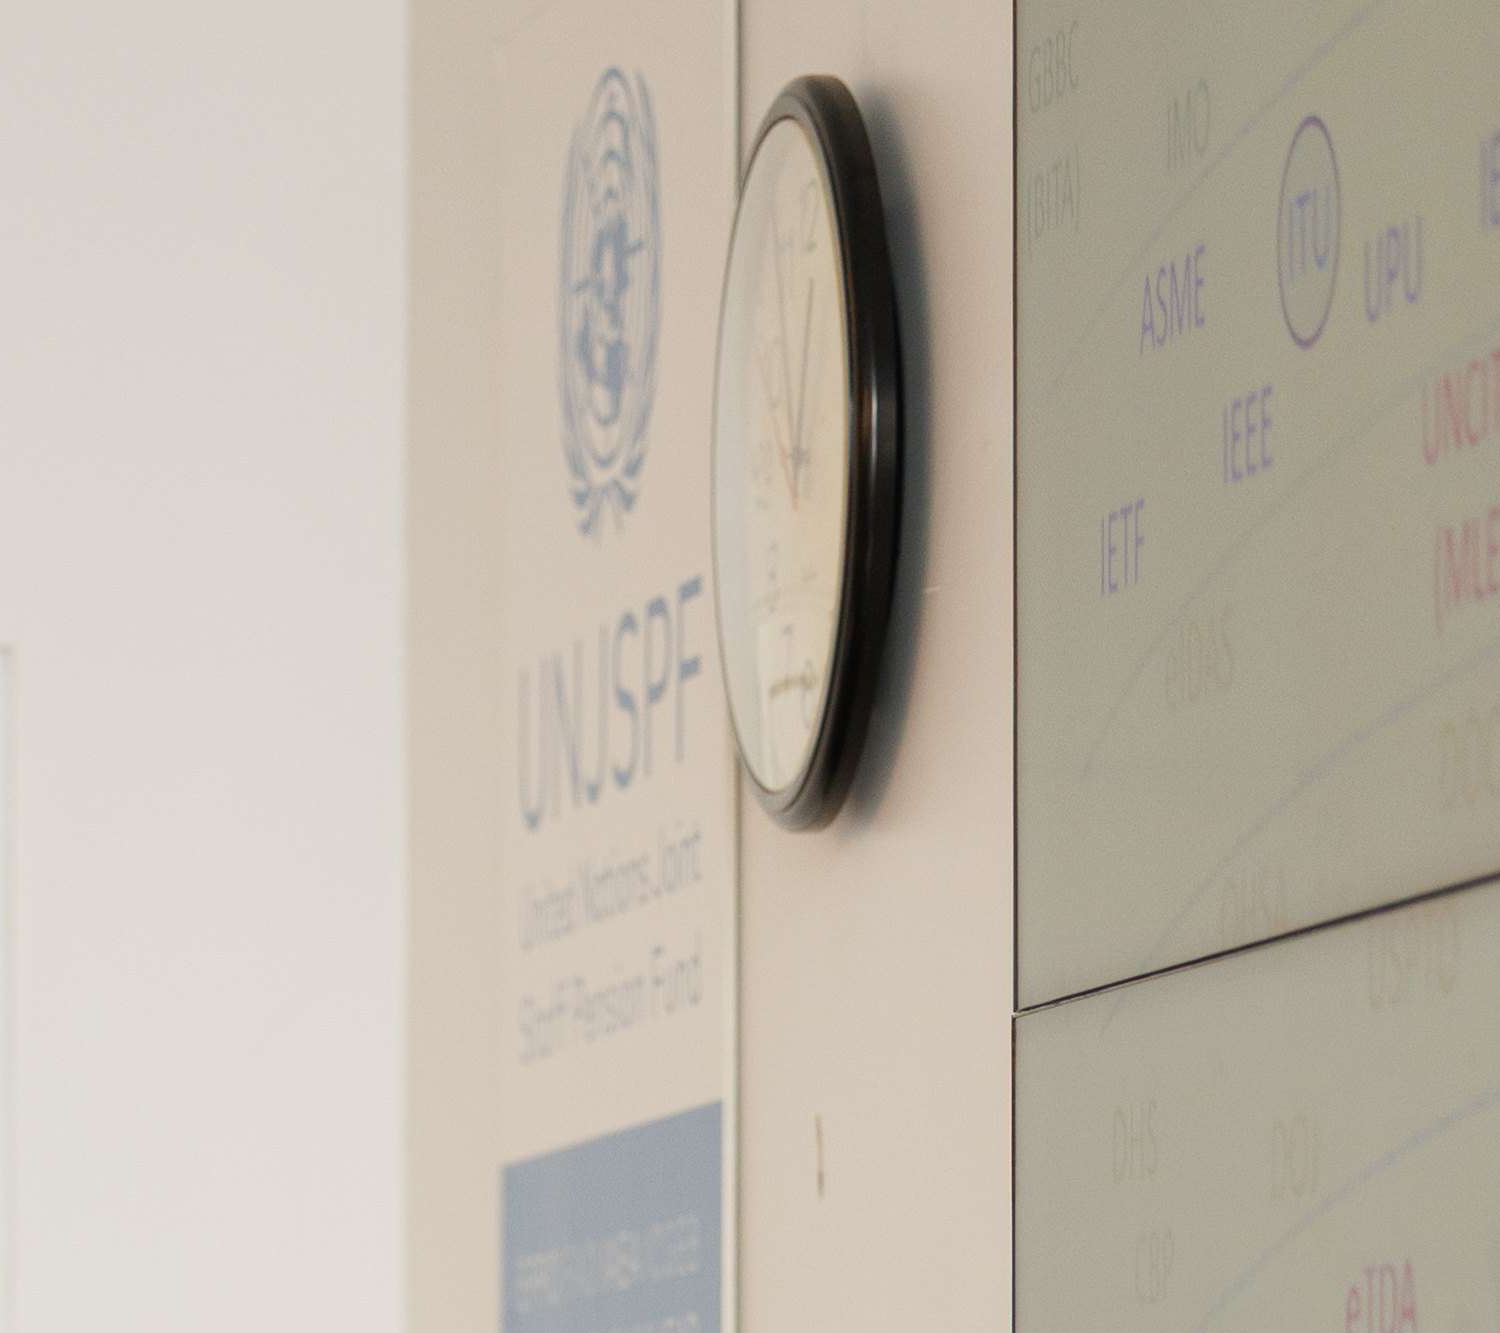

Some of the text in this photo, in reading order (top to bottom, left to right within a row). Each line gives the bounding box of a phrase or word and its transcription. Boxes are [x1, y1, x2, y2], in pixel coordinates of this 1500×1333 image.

[1284, 182, 1332, 282] ITU
[1362, 215, 1426, 325] UPU
[1139, 243, 1208, 358] ASME
[1221, 384, 1275, 487] IEEE
[1099, 496, 1147, 599] IETF
[517, 573, 703, 834] UNJSPF
